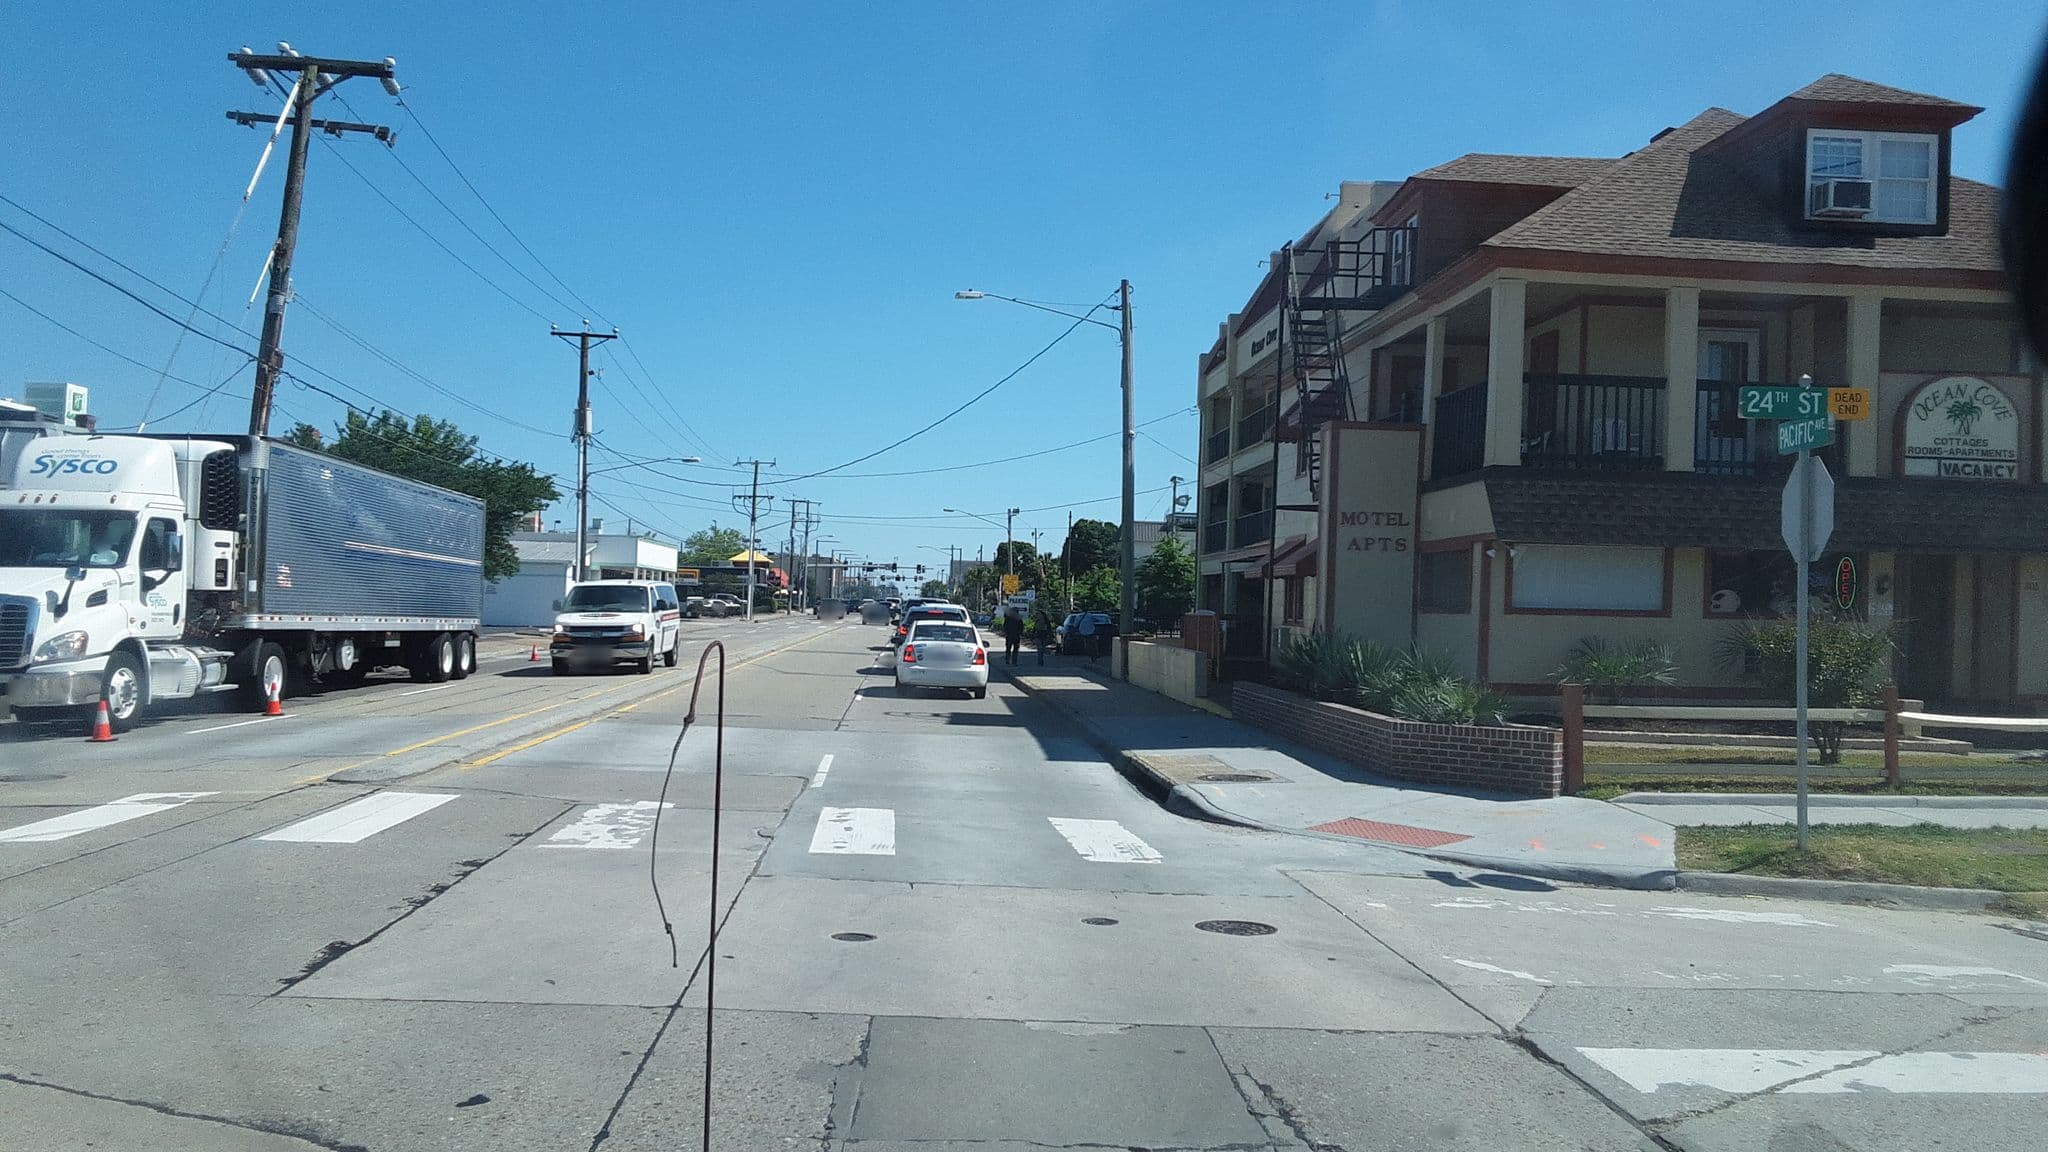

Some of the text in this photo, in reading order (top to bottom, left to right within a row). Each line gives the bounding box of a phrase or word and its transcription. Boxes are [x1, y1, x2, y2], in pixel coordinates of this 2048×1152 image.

[1746, 391, 1823, 414] 24TH ST
[1834, 392, 1862, 404] DEAD
[1914, 384, 2013, 421] OCEAN COVE
[1838, 404, 1860, 415] END
[1780, 418, 1826, 449] PACIFIC AVE
[1933, 437, 1989, 448] COTTAGES
[1941, 462, 2017, 478] VACANCY
[1340, 511, 1410, 527] MOTEL
[1347, 537, 1408, 552] APTS
